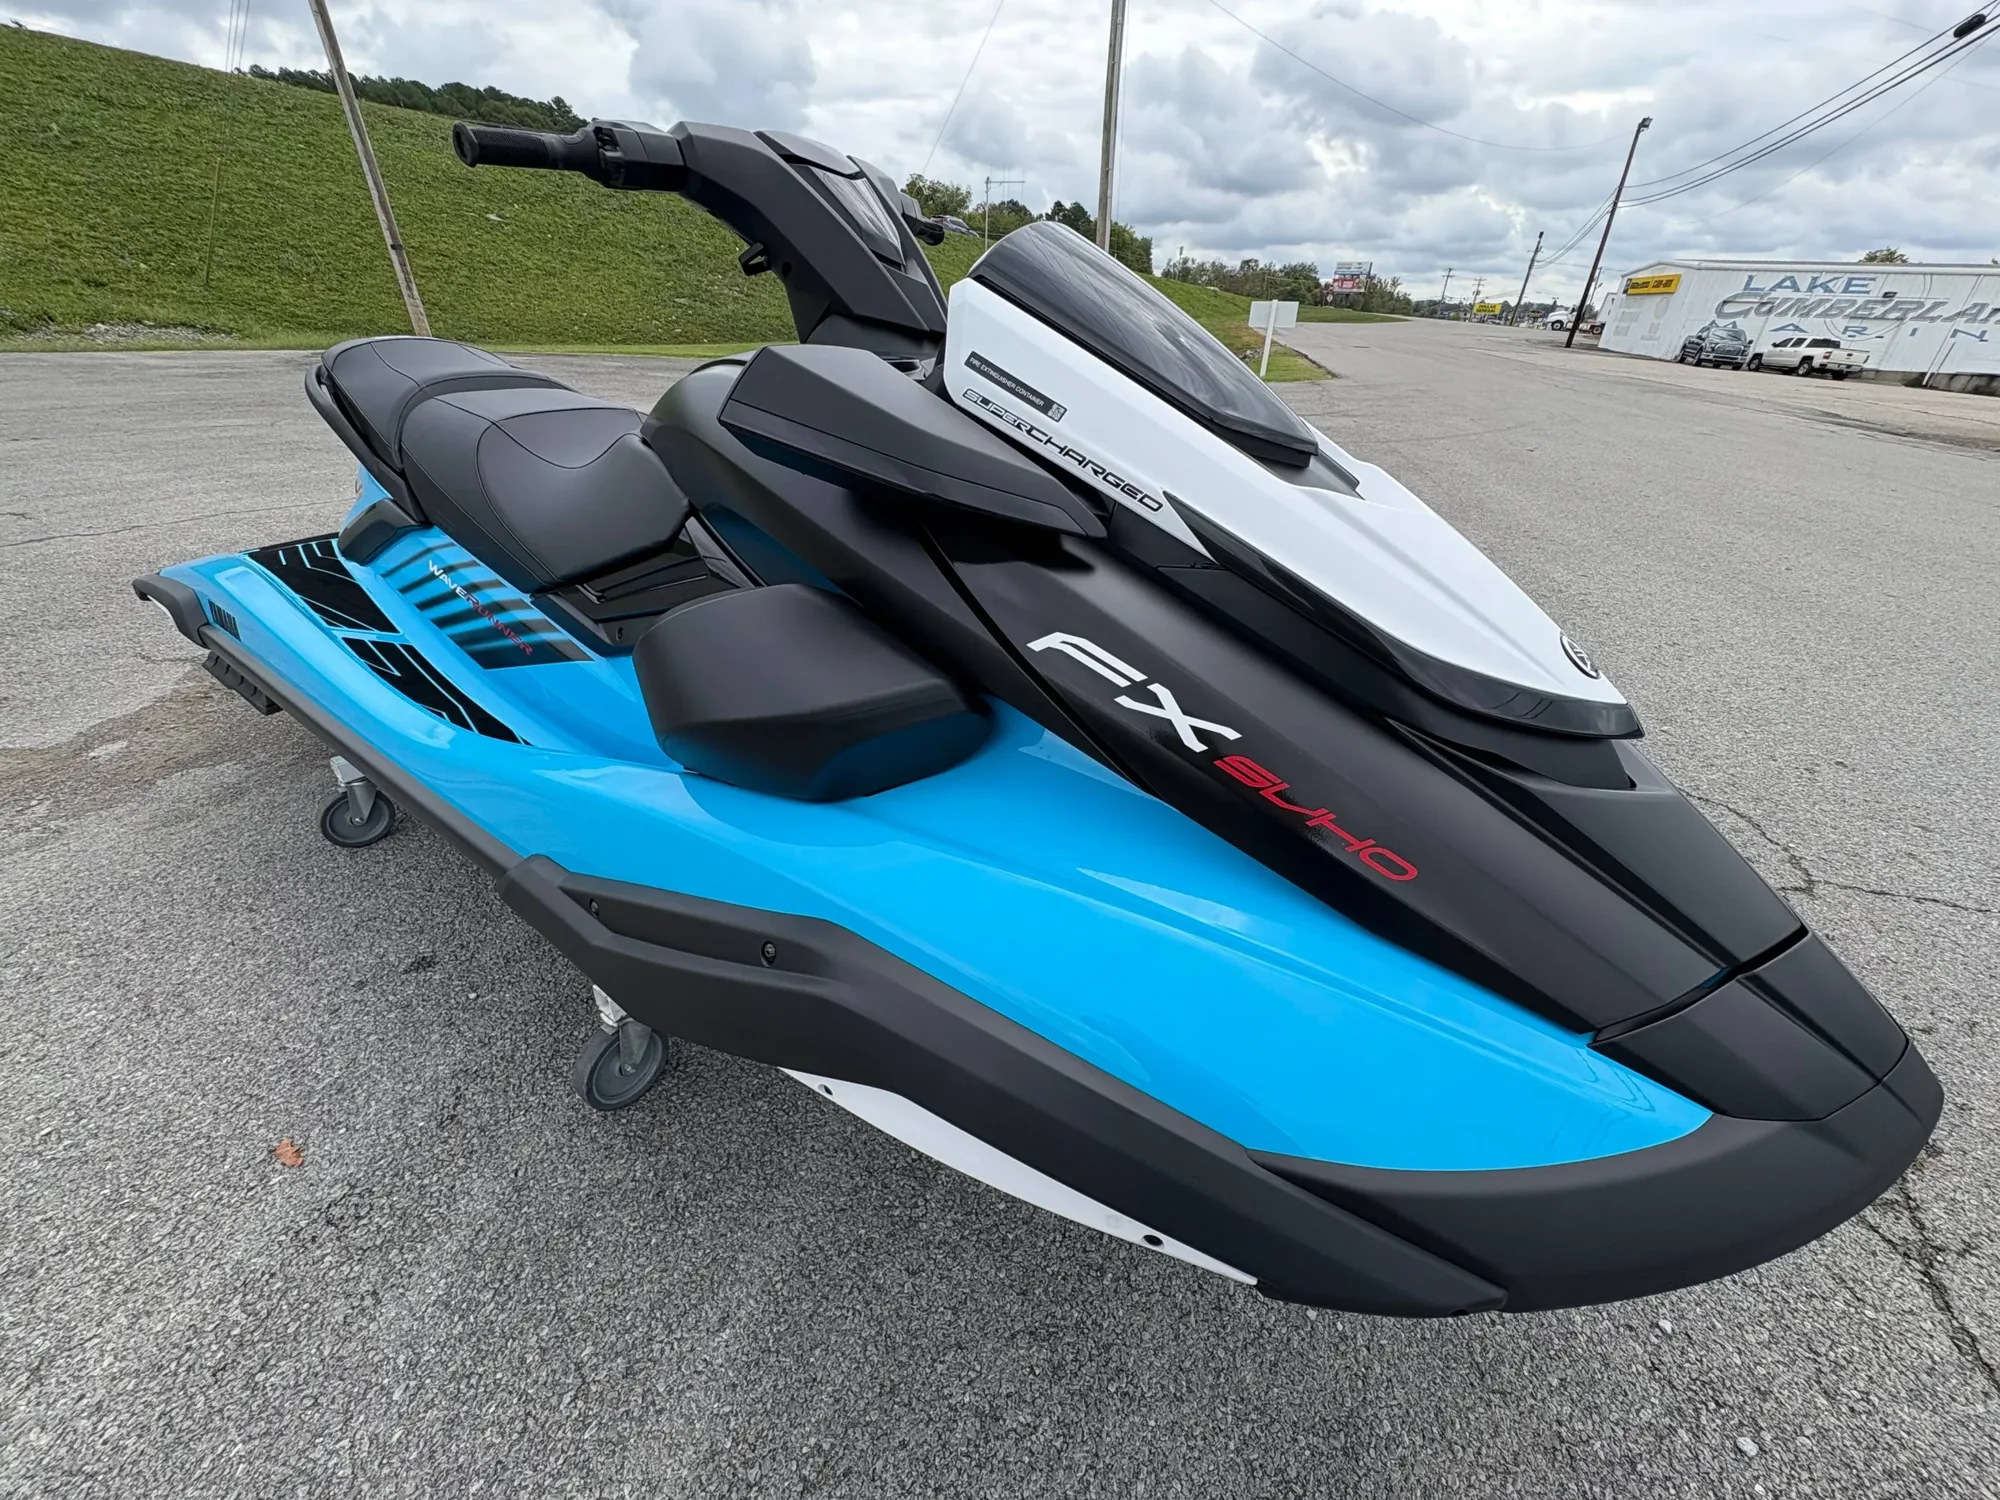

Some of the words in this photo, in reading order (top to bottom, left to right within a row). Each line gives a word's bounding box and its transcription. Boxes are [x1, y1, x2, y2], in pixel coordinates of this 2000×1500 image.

[1741, 275, 1877, 294] LAKE
[969, 357, 982, 368] FIRE
[980, 363, 1017, 390] EXTINGUISHER
[1015, 386, 1045, 407] CONTAINER
[962, 388, 1164, 513] SUPERCHARGED
[428, 559, 533, 656] WAVERUNNER
[1026, 631, 1243, 753] FX
